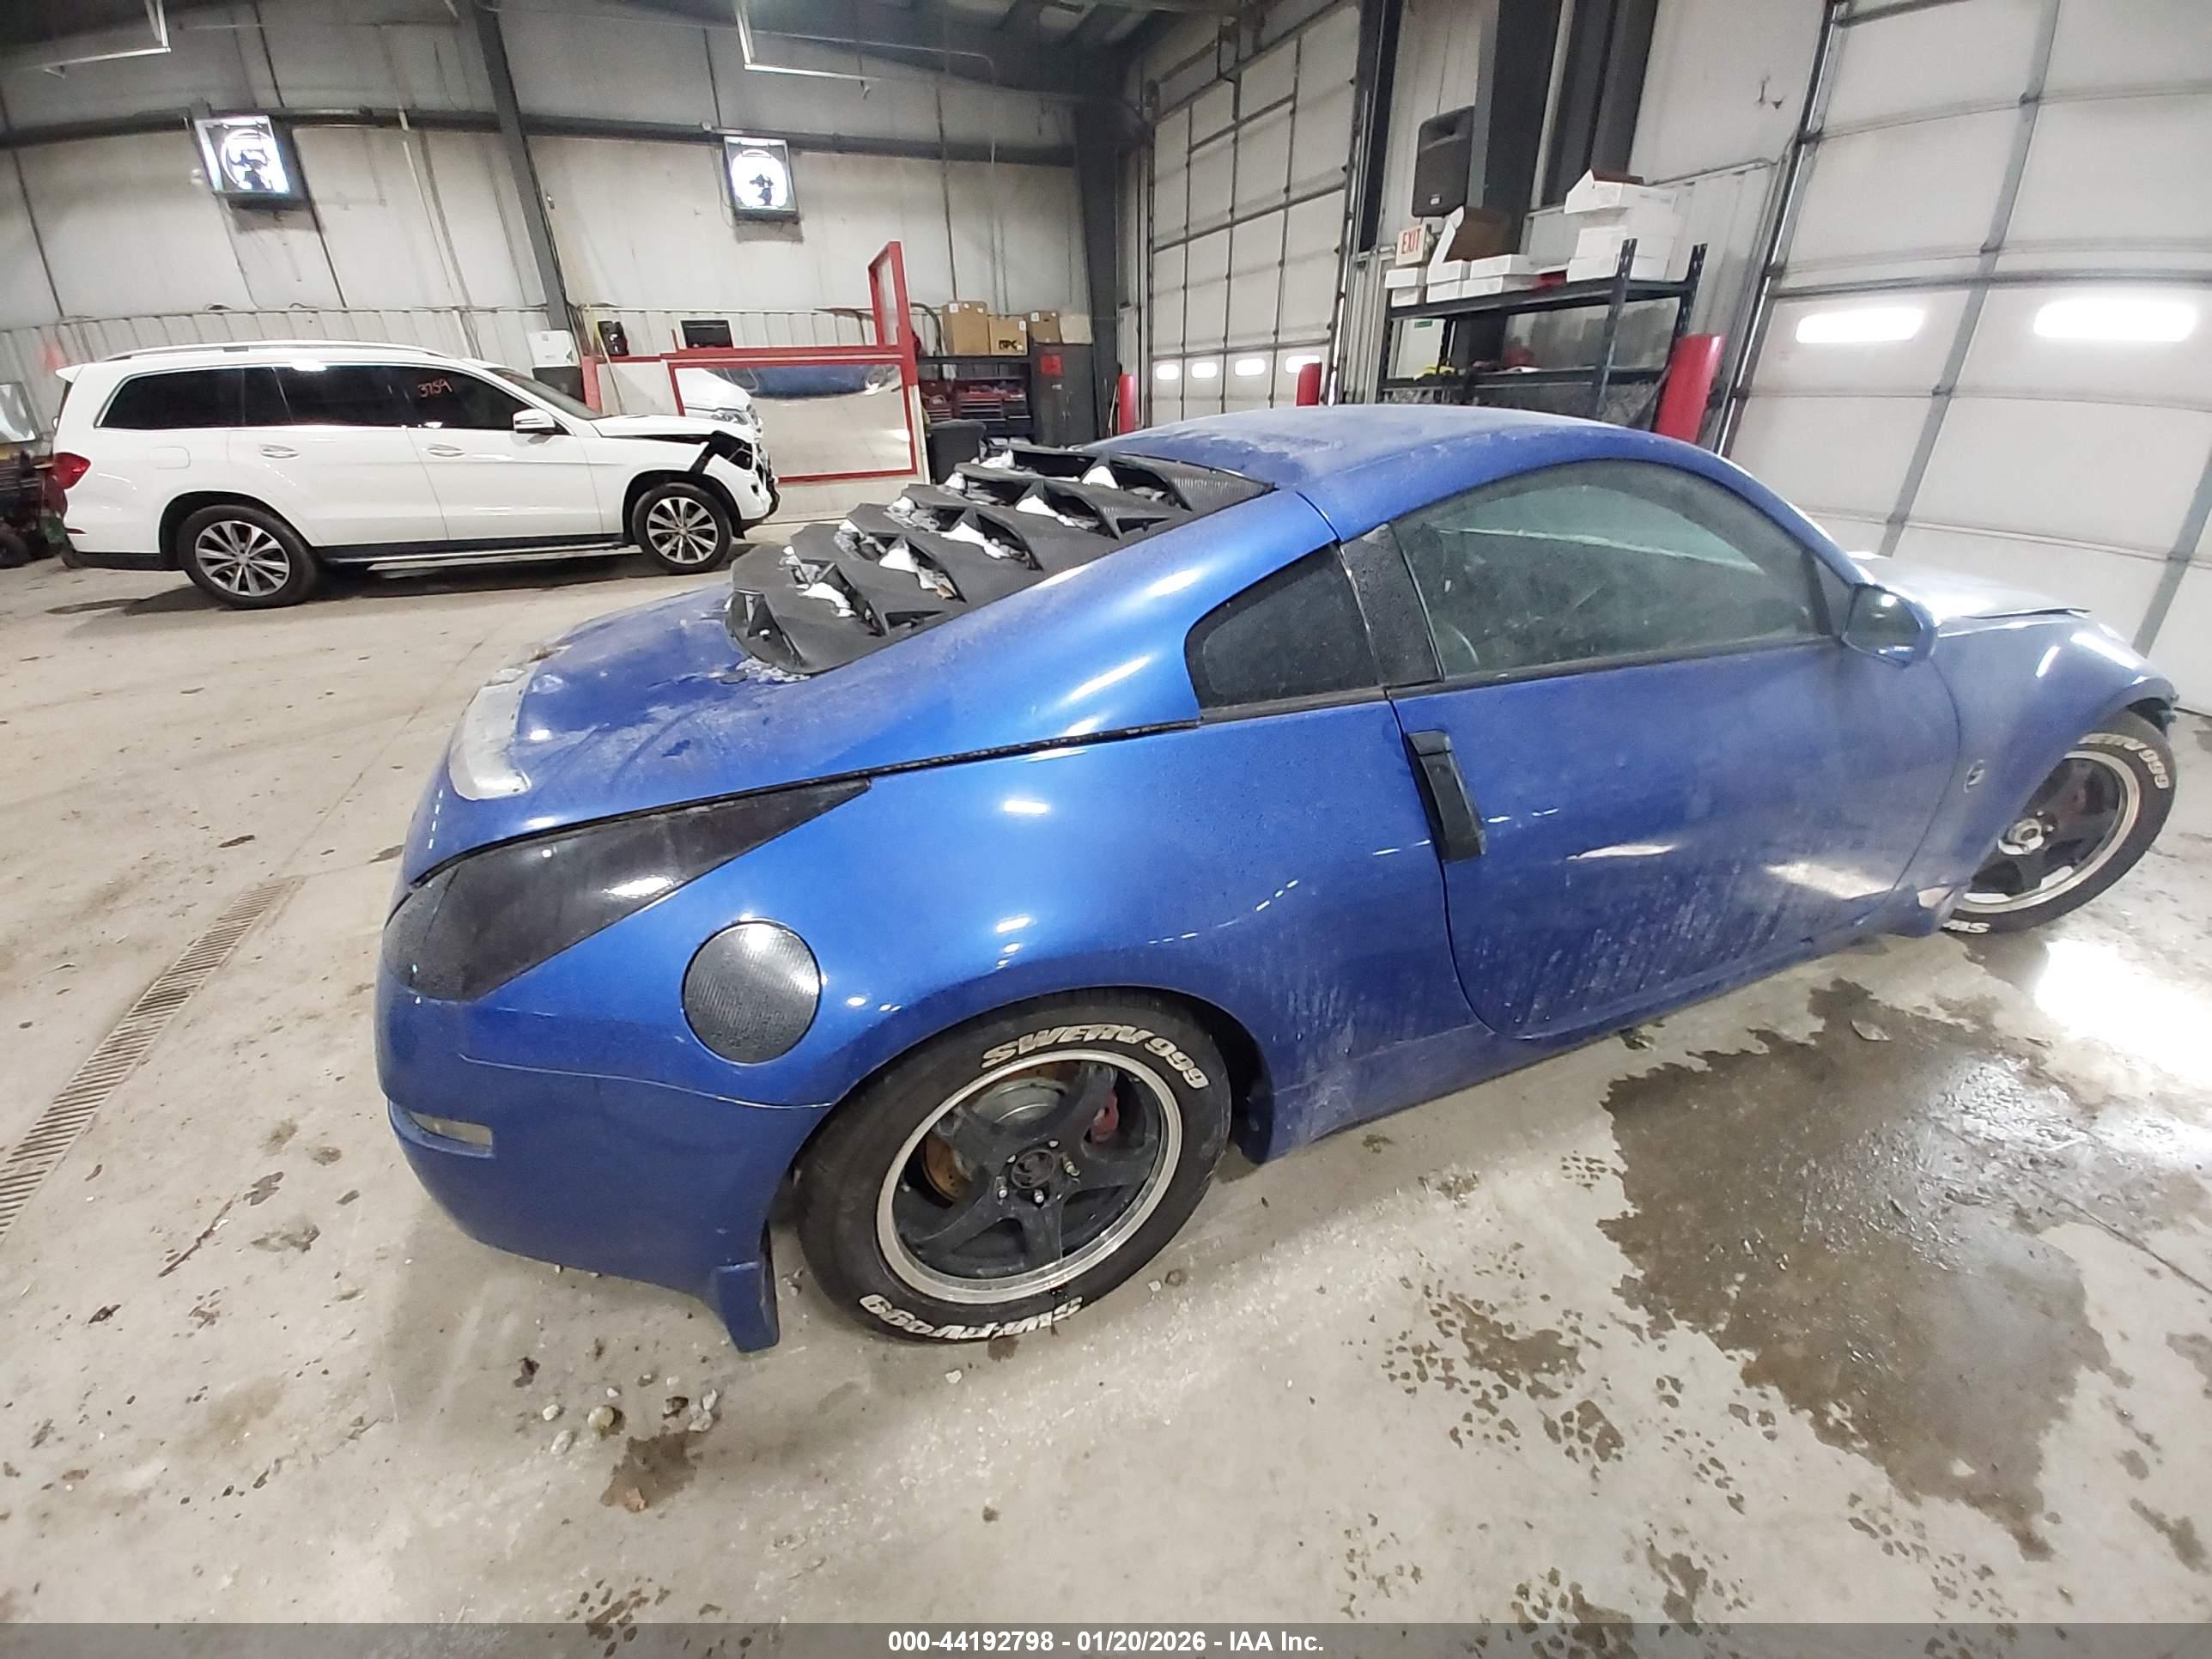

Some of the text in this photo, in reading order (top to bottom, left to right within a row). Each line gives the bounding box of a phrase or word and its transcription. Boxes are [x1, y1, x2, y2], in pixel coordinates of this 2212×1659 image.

[1401, 228, 1421, 254] EXIT
[417, 378, 453, 398] 3759
[981, 1023, 1211, 1090] SWERV 999
[859, 1293, 934, 1338] 999
